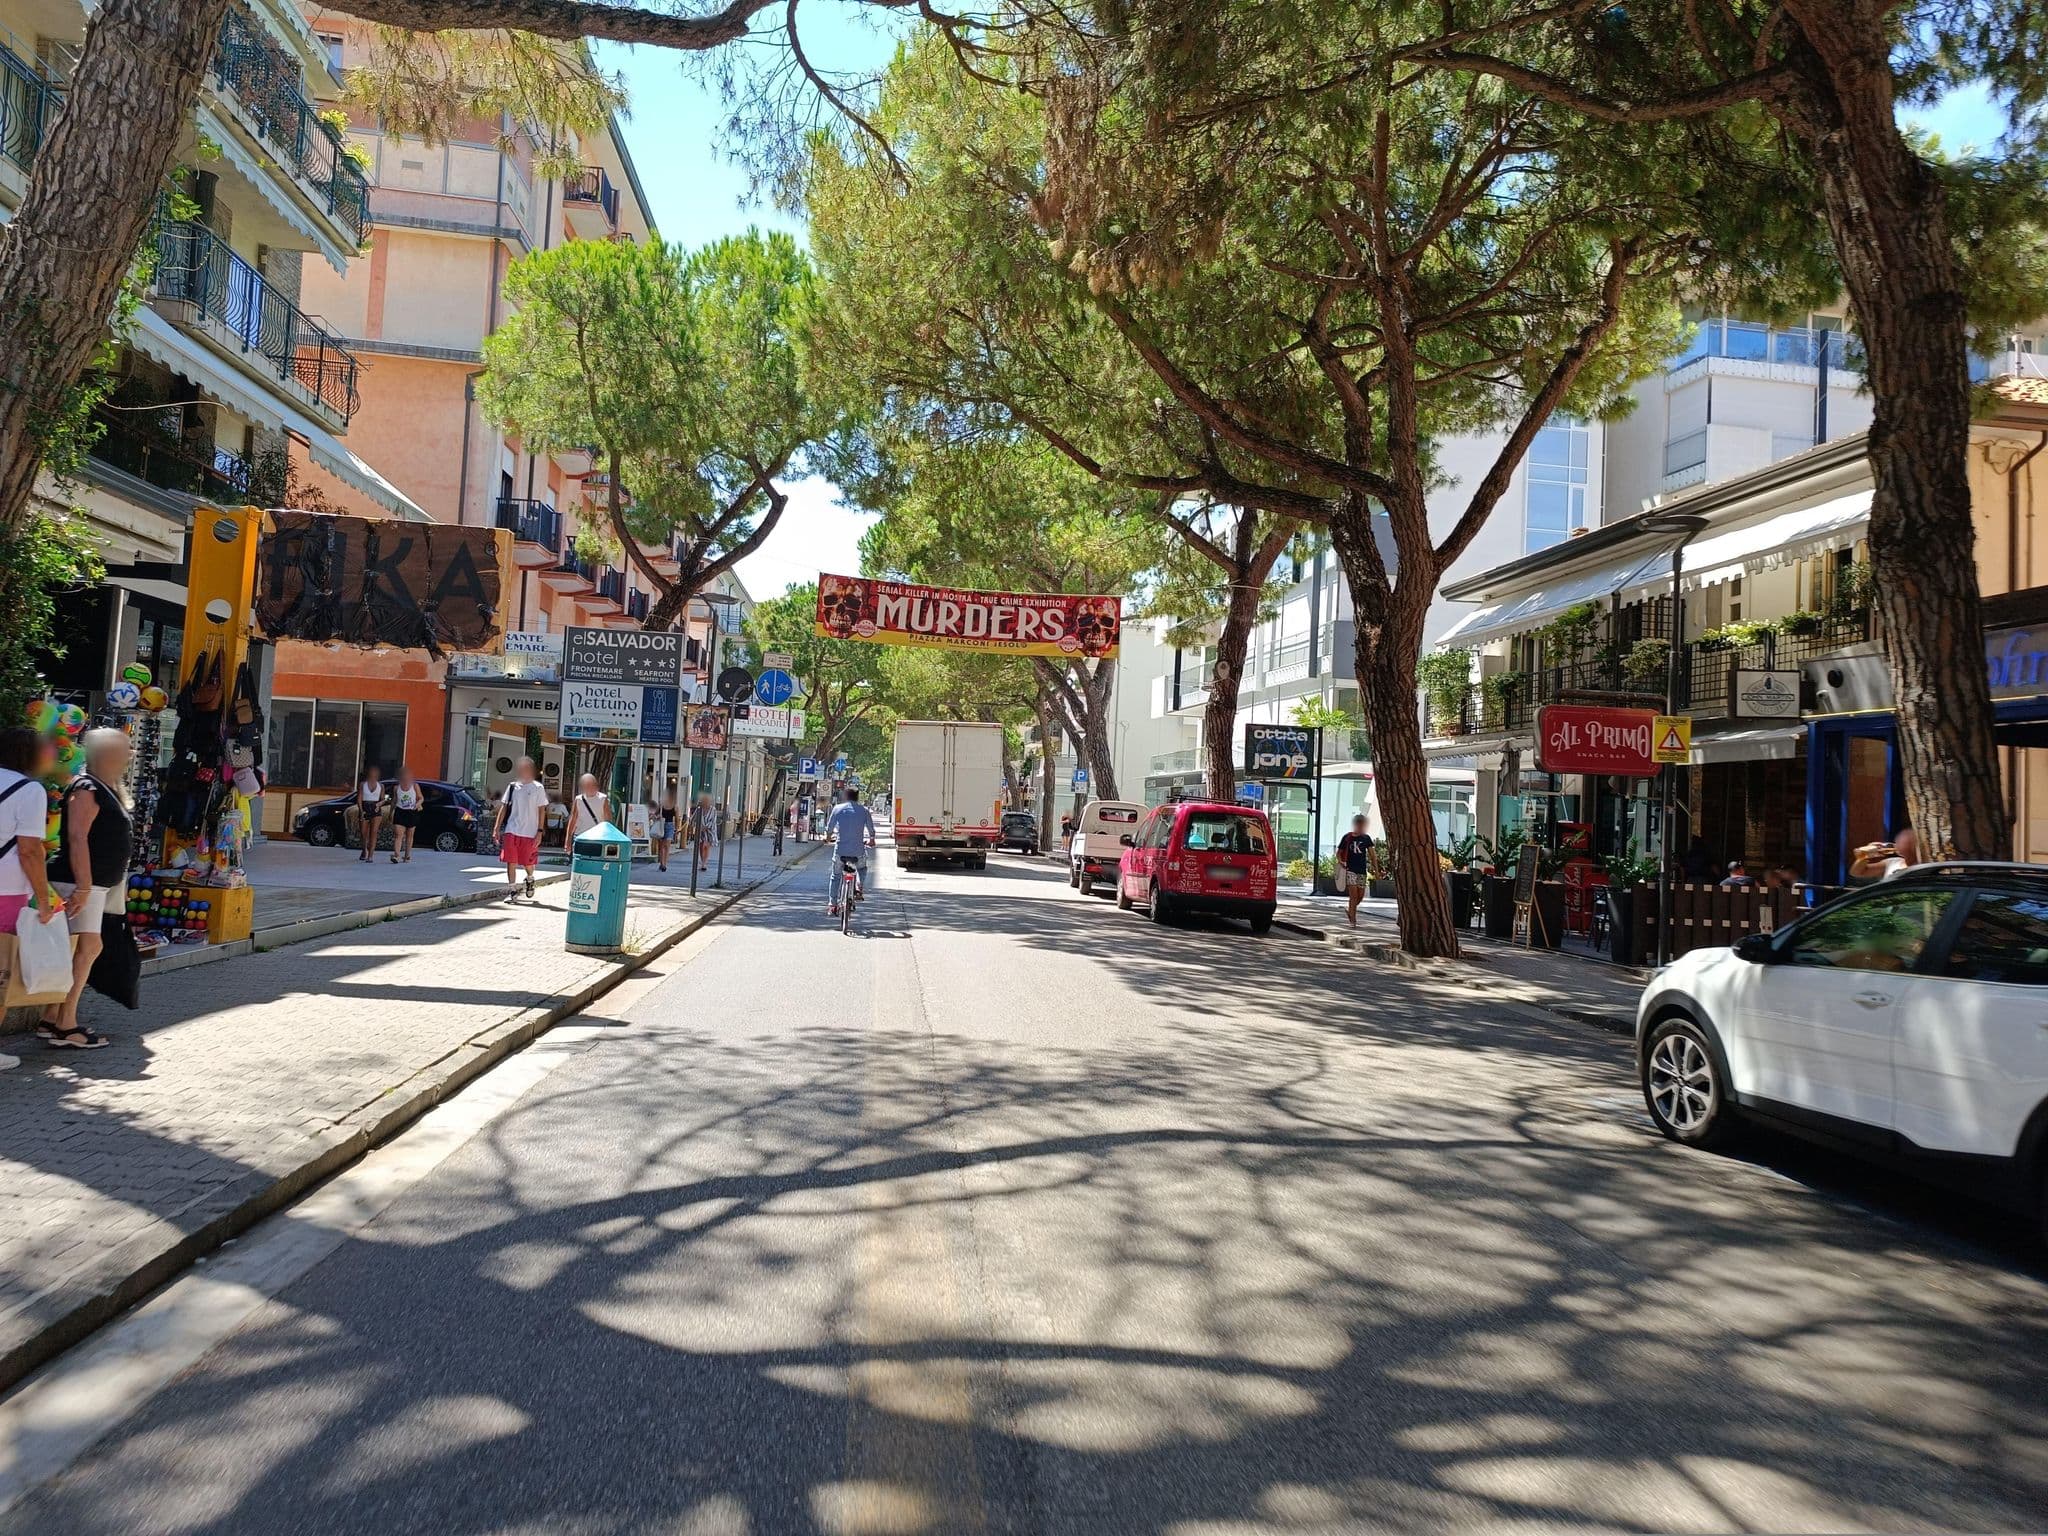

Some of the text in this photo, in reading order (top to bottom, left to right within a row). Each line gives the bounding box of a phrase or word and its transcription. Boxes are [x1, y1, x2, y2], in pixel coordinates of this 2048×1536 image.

[877, 585, 902, 595] SERIAL
[905, 588, 930, 599] KILLER
[942, 592, 972, 603] MOSTRA
[980, 596, 998, 605] TRUE
[1000, 597, 1023, 606] CRIME
[1026, 598, 1067, 608] EXHIBITION
[875, 593, 1065, 641] MURDERS
[909, 633, 942, 643] PIAZZA
[946, 638, 989, 647] MARCONI
[994, 640, 1028, 648] JESOLO
[571, 647, 619, 665] hotel
[571, 665, 624, 675] FRONTEMARE
[634, 669, 675, 678] SEAFRONT
[585, 685, 622, 698] hotel
[507, 699, 541, 710] WINE
[1550, 720, 1650, 758] AL PRIMO
[802, 760, 812, 773] P
[1077, 771, 1085, 780] P
